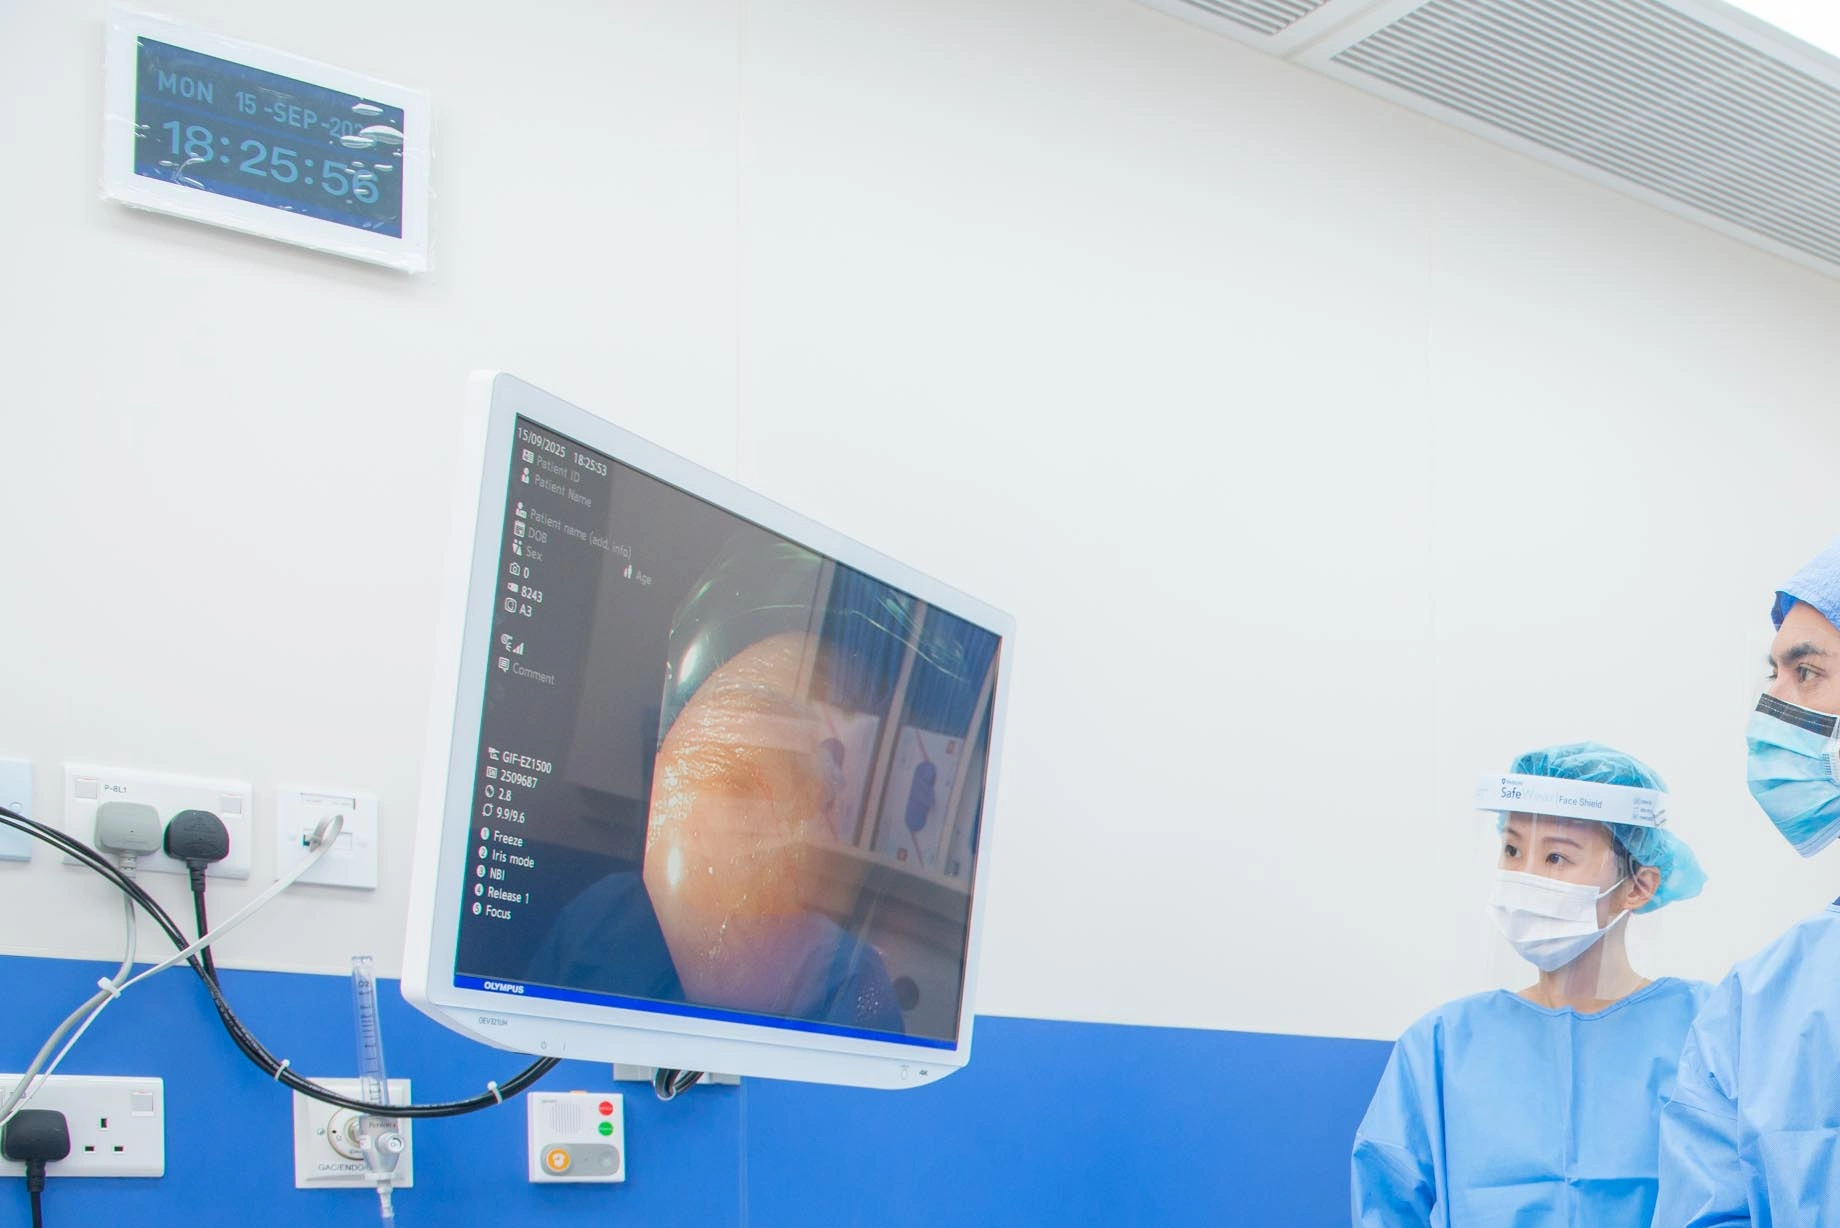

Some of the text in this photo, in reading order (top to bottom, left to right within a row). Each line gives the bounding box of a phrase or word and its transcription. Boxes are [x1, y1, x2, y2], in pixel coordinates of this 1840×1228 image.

[158, 70, 213, 104] MON
[518, 427, 607, 476] 15/09/2025 18:25:53
[536, 455, 580, 483] Patient ID
[534, 474, 592, 507] Patient Name
[528, 527, 547, 543] DOB
[530, 509, 562, 531] Patient
[564, 525, 586, 541] name
[612, 544, 632, 560] info)
[526, 546, 543, 561] Sex
[523, 567, 529, 578] 0
[635, 570, 652, 585] Age
[521, 586, 543, 602] 8243
[519, 604, 532, 617] A3
[513, 662, 555, 685] Comment
[503, 751, 552, 774] GIF-EZ1500
[500, 769, 538, 788] 2509687
[498, 788, 512, 801] 2.8
[1558, 795, 1577, 807] Face
[1579, 797, 1603, 809] Shield
[496, 807, 526, 824] 9.9/9.6
[494, 830, 524, 847] Freeze
[492, 849, 507, 862] Iris
[509, 855, 535, 868] mode
[489, 867, 505, 880] NBI
[488, 886, 522, 903] Release
[485, 905, 512, 920] Focus
[484, 981, 524, 994] OLYMPUS
